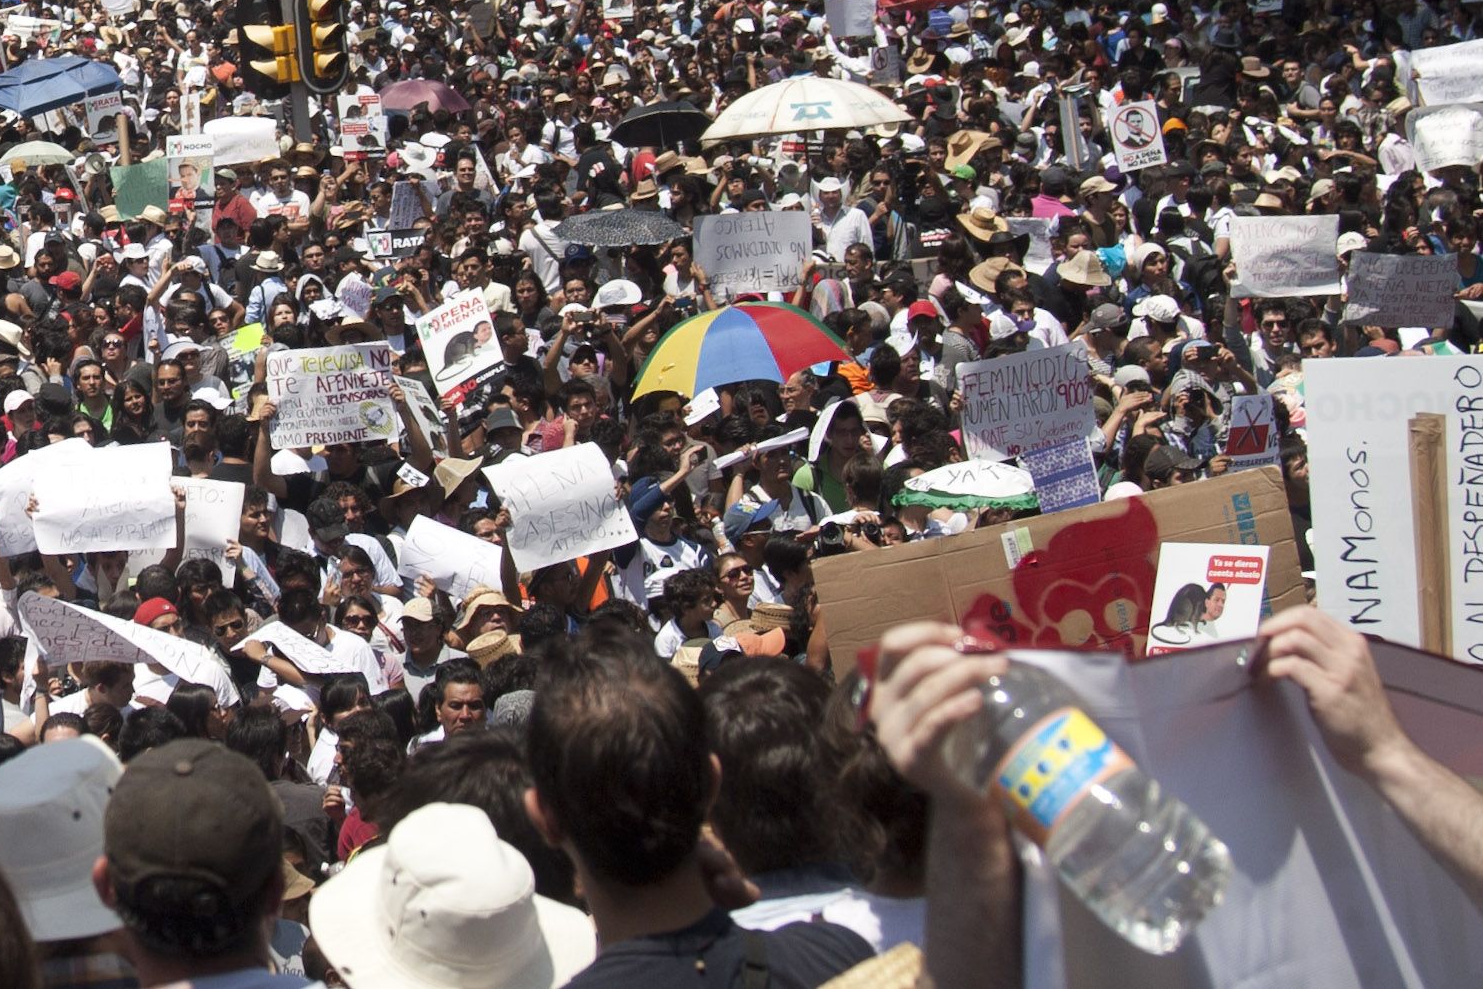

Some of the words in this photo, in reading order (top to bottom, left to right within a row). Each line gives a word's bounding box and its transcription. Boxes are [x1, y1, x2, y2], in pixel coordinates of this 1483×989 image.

[393, 236, 425, 248] RATA
[790, 241, 806, 263] NO
[443, 306, 484, 329] MIENTO
[370, 350, 390, 369] NO
[316, 371, 390, 393] APENDEJE
[325, 389, 387, 405] TELEVISORAS
[296, 406, 345, 418] QUIEREN
[271, 433, 302, 447] COMO
[306, 427, 368, 444] PRESIDENTE
[1007, 444, 1020, 456] NO
[60, 524, 83, 547] NO
[87, 525, 109, 543] AL
[1213, 559, 1222, 567] Ya
[1235, 559, 1258, 568] dieron
[1208, 570, 1234, 578] cuenta
[1236, 570, 1261, 579] abuelo
